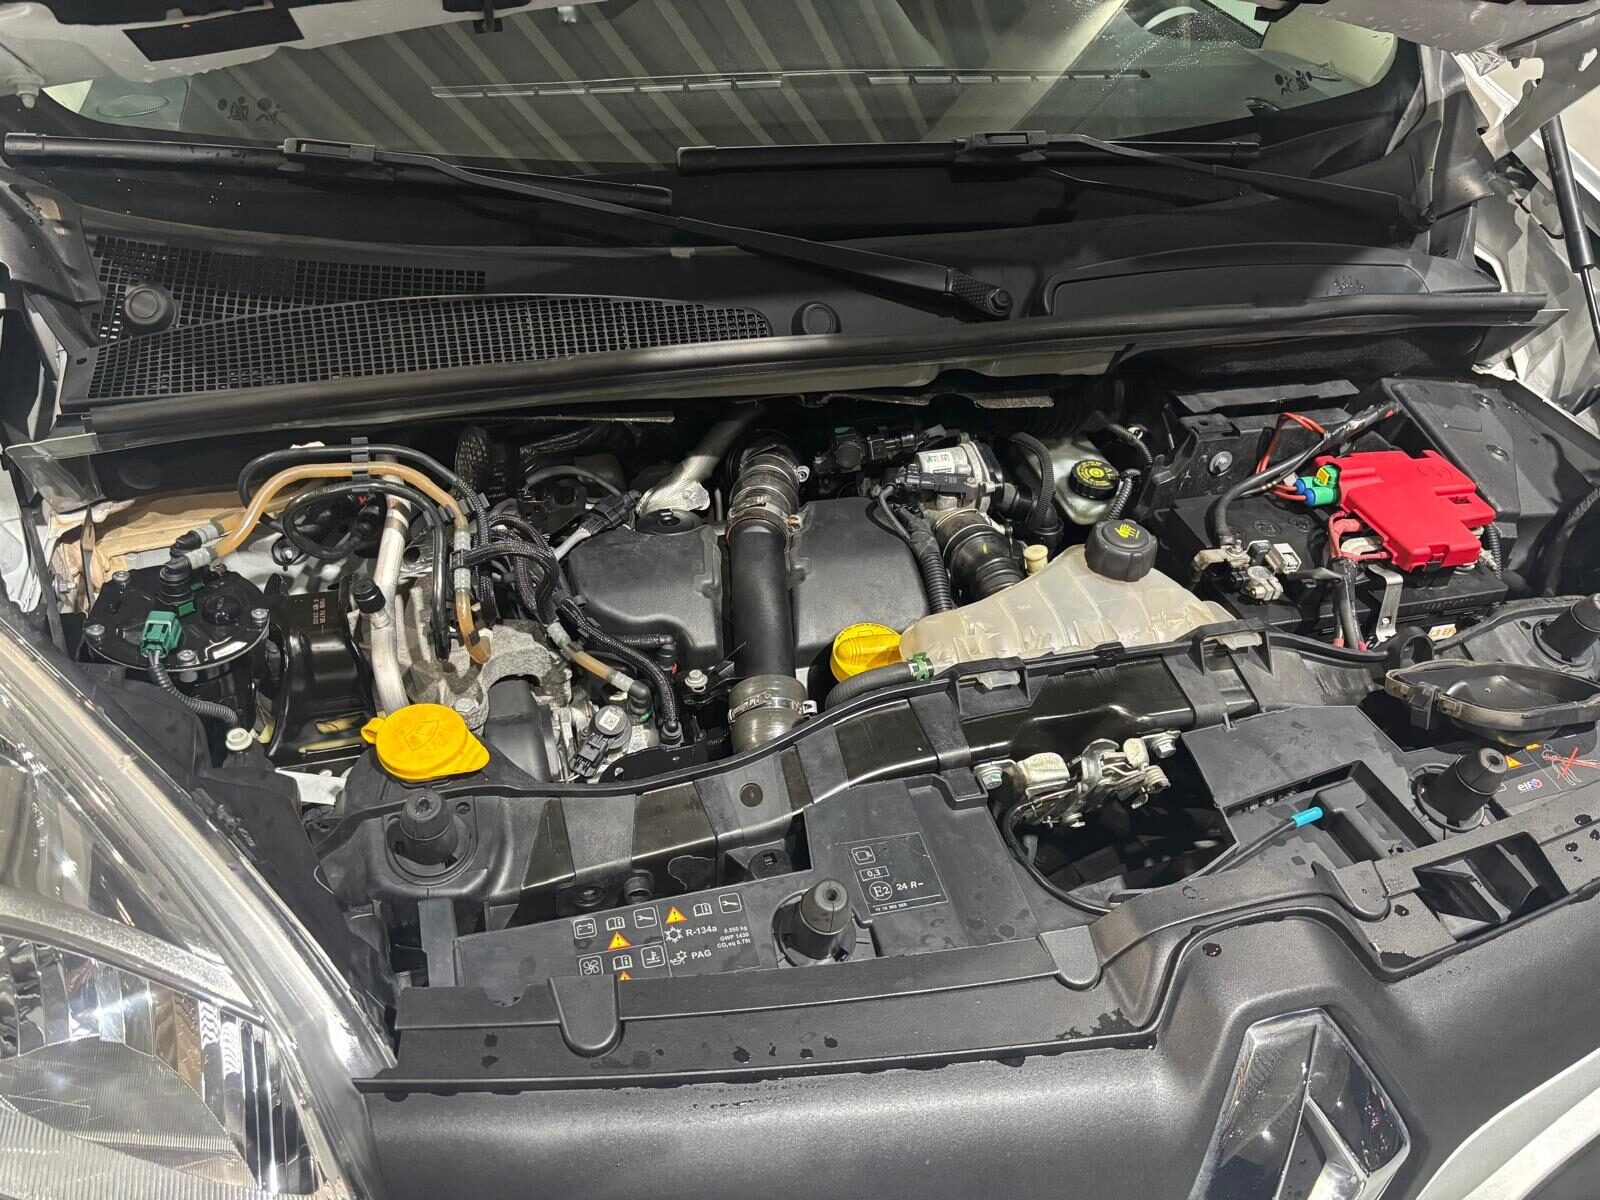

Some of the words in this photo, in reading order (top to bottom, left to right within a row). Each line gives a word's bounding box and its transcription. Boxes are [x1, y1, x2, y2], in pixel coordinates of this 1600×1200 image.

[1518, 781, 1532, 791] elf
[867, 869, 880, 878] 0,3
[896, 883, 908, 891] 24
[685, 925, 717, 937] R-134a
[691, 949, 712, 959] PAG
